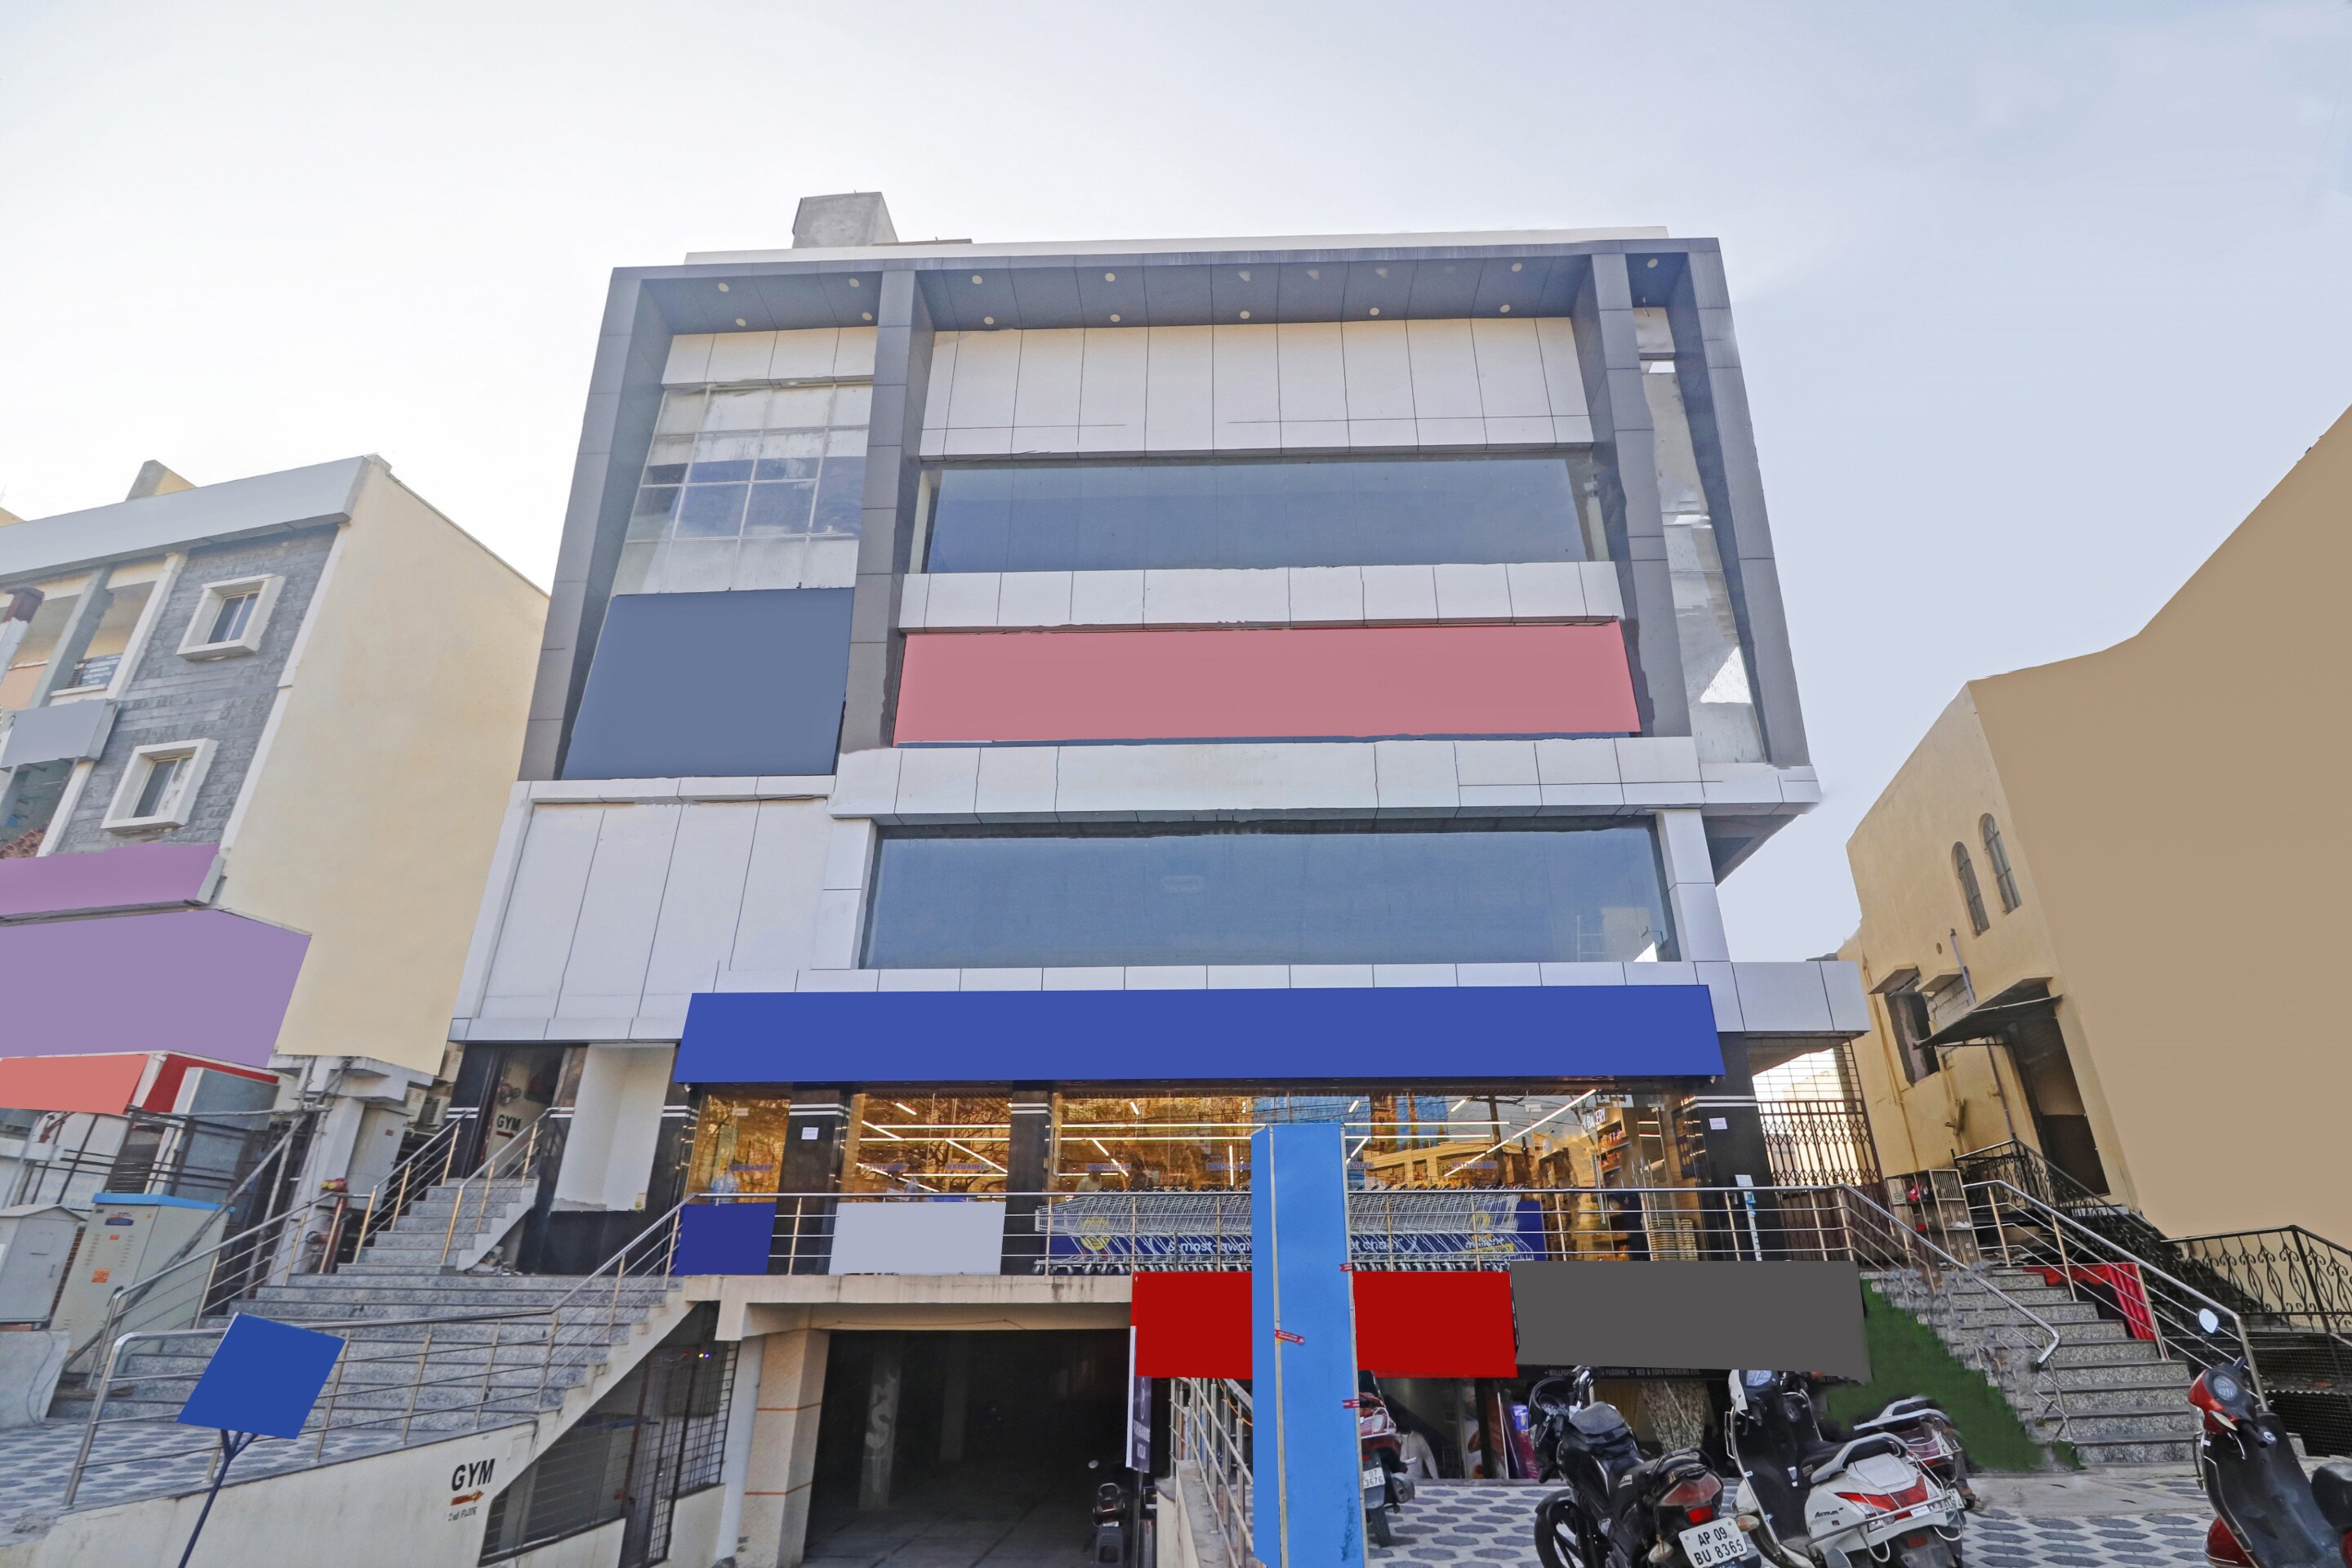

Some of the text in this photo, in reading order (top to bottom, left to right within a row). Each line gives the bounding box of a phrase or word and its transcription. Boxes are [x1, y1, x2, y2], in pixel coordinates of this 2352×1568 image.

[497, 1114, 522, 1132] GYM
[947, 1163, 991, 1171] RATNADEEP
[1180, 1240, 1251, 1252] most-awar
[451, 1458, 496, 1492] GYM
[1365, 1476, 1384, 1486] 3676
[1697, 1526, 1728, 1547] AP 09
[1694, 1539, 1744, 1566] BU 8365
